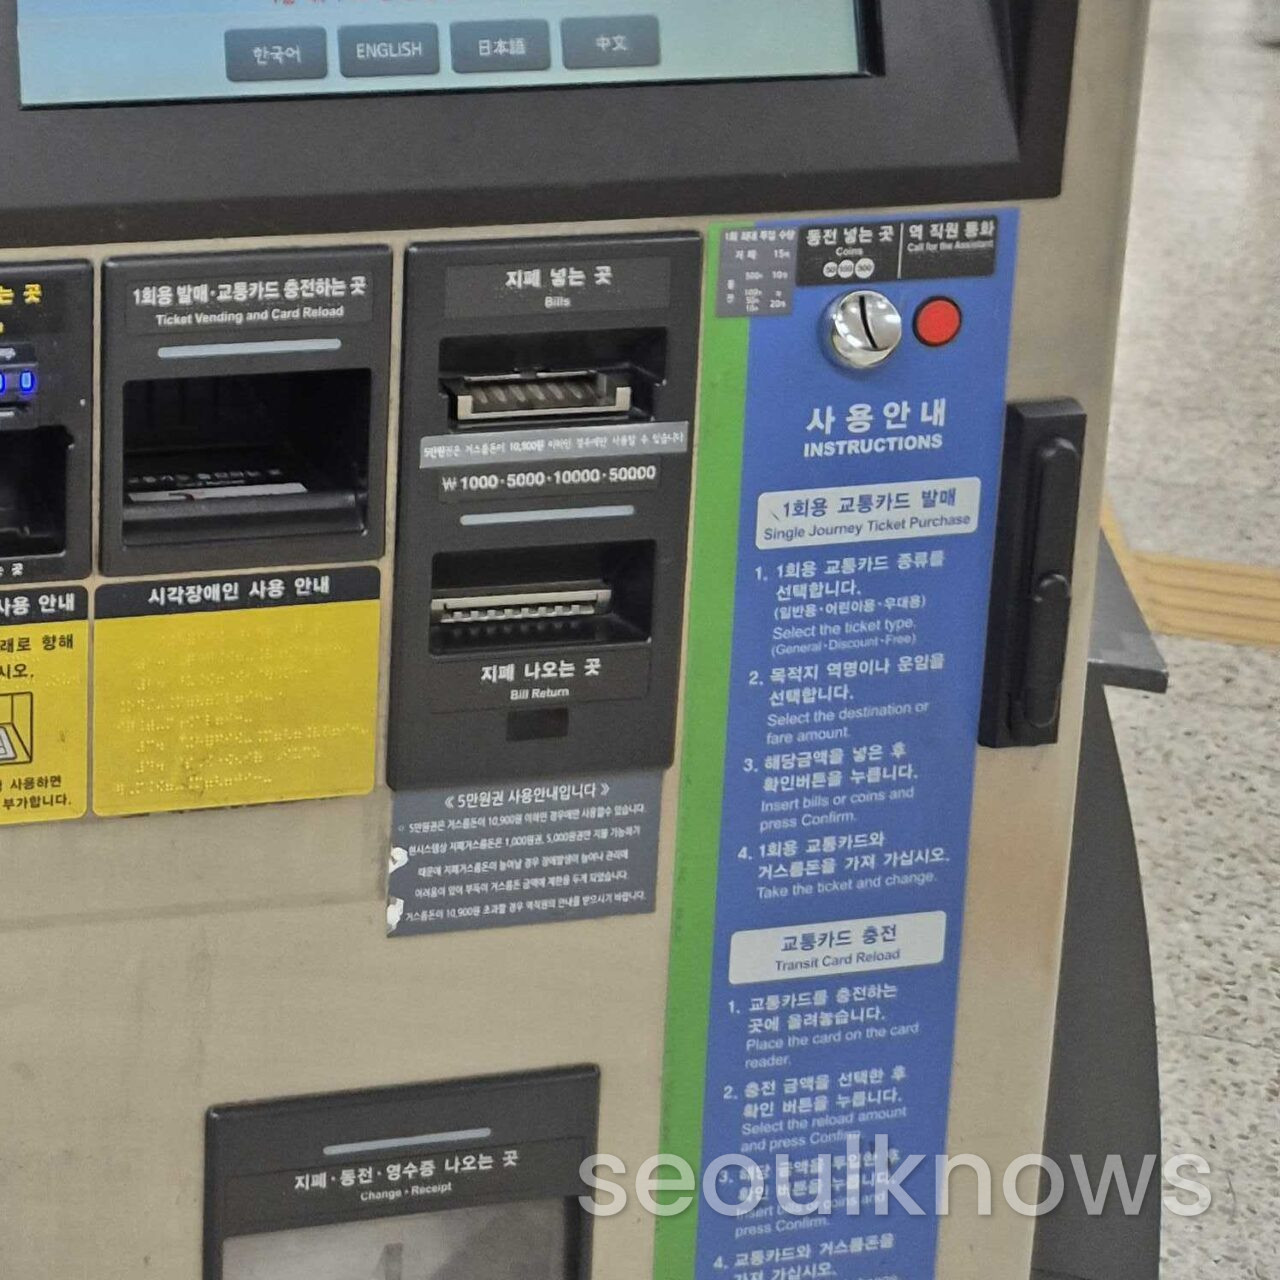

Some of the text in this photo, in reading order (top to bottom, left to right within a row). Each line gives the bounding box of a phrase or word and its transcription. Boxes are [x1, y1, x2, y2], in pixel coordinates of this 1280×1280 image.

[355, 41, 422, 59] ENGLISH
[478, 37, 526, 57] 日本語
[595, 35, 628, 52] 中文
[253, 47, 301, 65] 한국어
[806, 224, 894, 247] 동전 넣는 곳
[909, 220, 996, 241] 역 직원 통화
[836, 246, 864, 258] Coins
[505, 266, 613, 289] 지폐 넣는 곳
[23, 283, 43, 304] 곳
[133, 285, 173, 307] 1회용
[284, 276, 347, 300] 충전하는
[350, 276, 367, 296] 곳
[545, 296, 571, 309] Bills
[156, 305, 344, 326] Ticket Vending and Card Reload
[803, 433, 943, 458] INSTRUCTIONS
[783, 488, 956, 518] 1회용 교통카드 발매
[763, 514, 971, 542] Single Journey Ticket Purchase
[755, 566, 768, 581] 1.
[777, 561, 817, 579] 1회용
[824, 556, 889, 575] 교통카드
[148, 576, 330, 606] 시각장애인 사용 안내
[776, 580, 861, 601] 선택합니다.
[38, 593, 75, 613] 안내
[773, 617, 915, 641] Select the ticket type.
[42, 633, 73, 651] 향해
[481, 657, 602, 683] 지폐 나오는 곳
[749, 653, 945, 686] 2. 목적지 역명이나 운임을
[510, 687, 569, 700] Bill Return
[769, 684, 854, 707] 선택합니다.
[767, 701, 929, 727] Select the destination or
[766, 732, 793, 745] fare
[10, 775, 61, 791] 사용하면
[457, 783, 597, 809] 5만원권 사용안내입니다
[761, 787, 914, 812] Insert bills or coins and
[760, 811, 857, 833] press Confirm.
[757, 871, 937, 899] Take the ticket and change.
[781, 924, 897, 952] 교통카드 충전
[775, 949, 901, 972] Transit Card Reload
[746, 1022, 920, 1052] Place the card on the card
[444, 1153, 493, 1173] 나오는
[502, 1149, 519, 1168] 곳
[360, 1181, 452, 1202] Change Receipt
